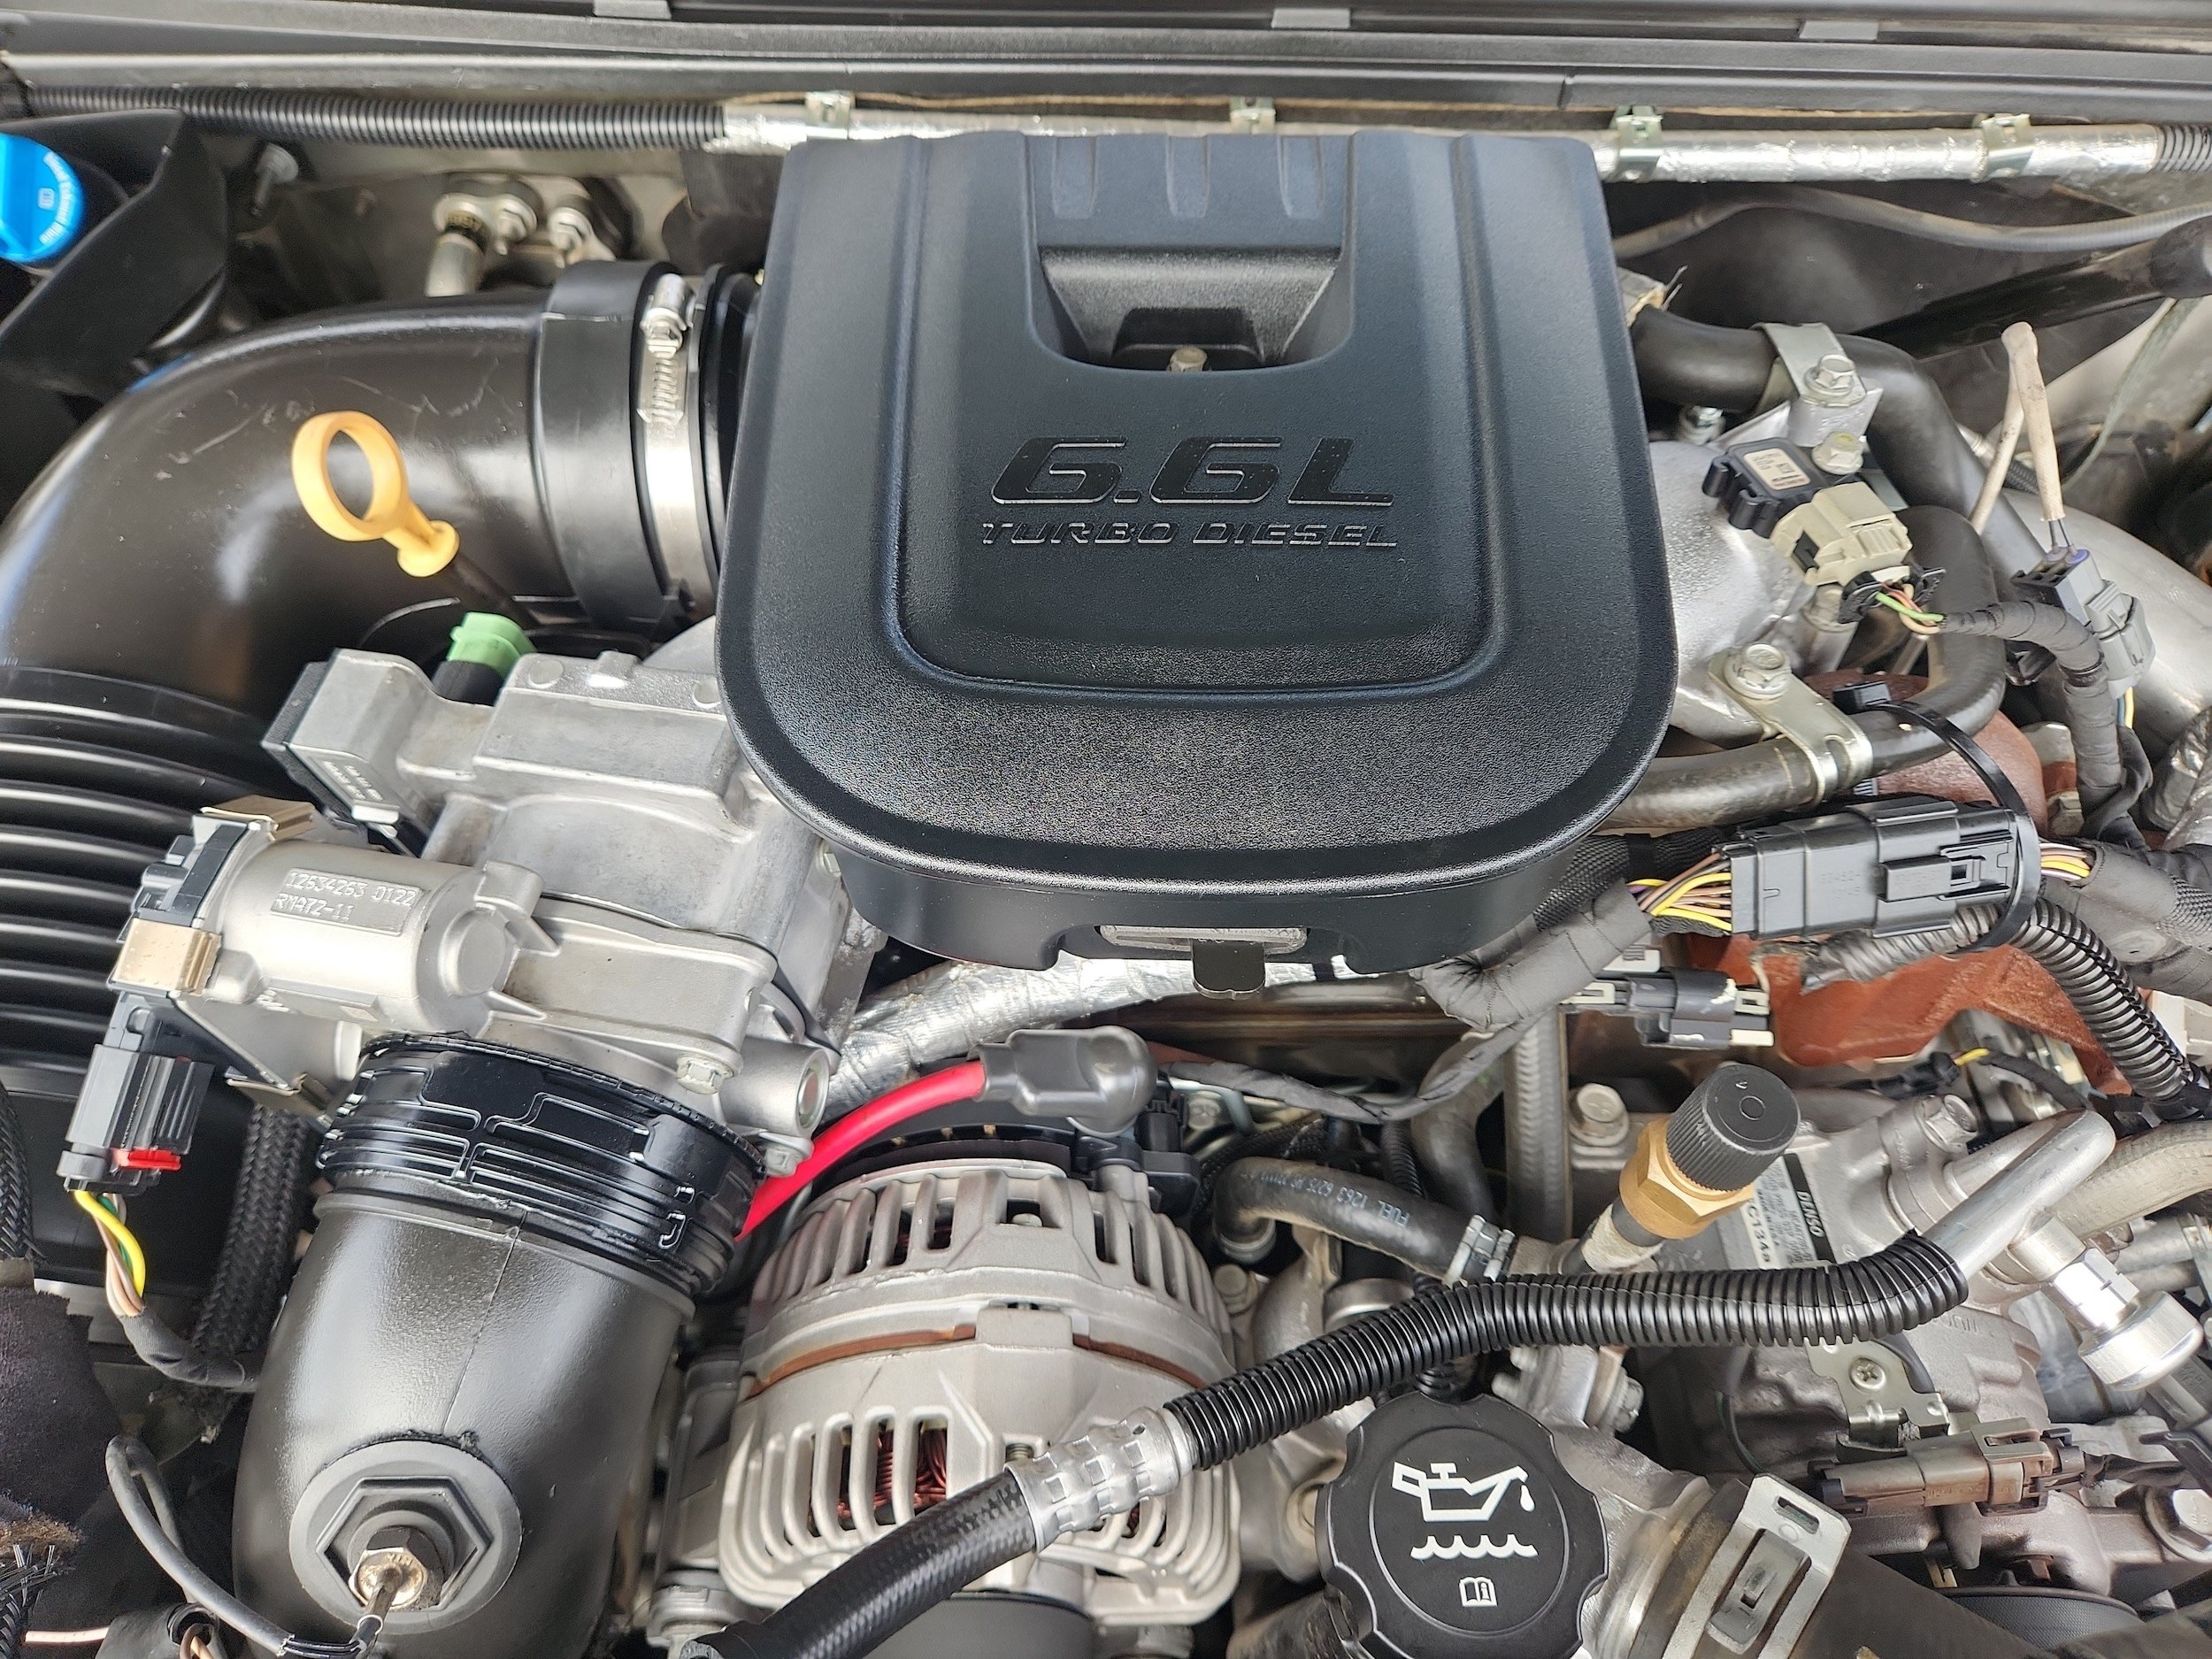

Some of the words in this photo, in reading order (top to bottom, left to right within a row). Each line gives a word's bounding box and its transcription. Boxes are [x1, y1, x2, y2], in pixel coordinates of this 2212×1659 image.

[991, 436, 1394, 507] 6.6L
[982, 522, 1179, 545] TURBO
[1192, 522, 1397, 547] DIESEL
[1336, 1187, 1368, 1210] 1263
[1378, 1200, 1410, 1227] FUEL
[1796, 1190, 1825, 1238] DENSO
[1746, 1202, 1770, 1263] C134a
